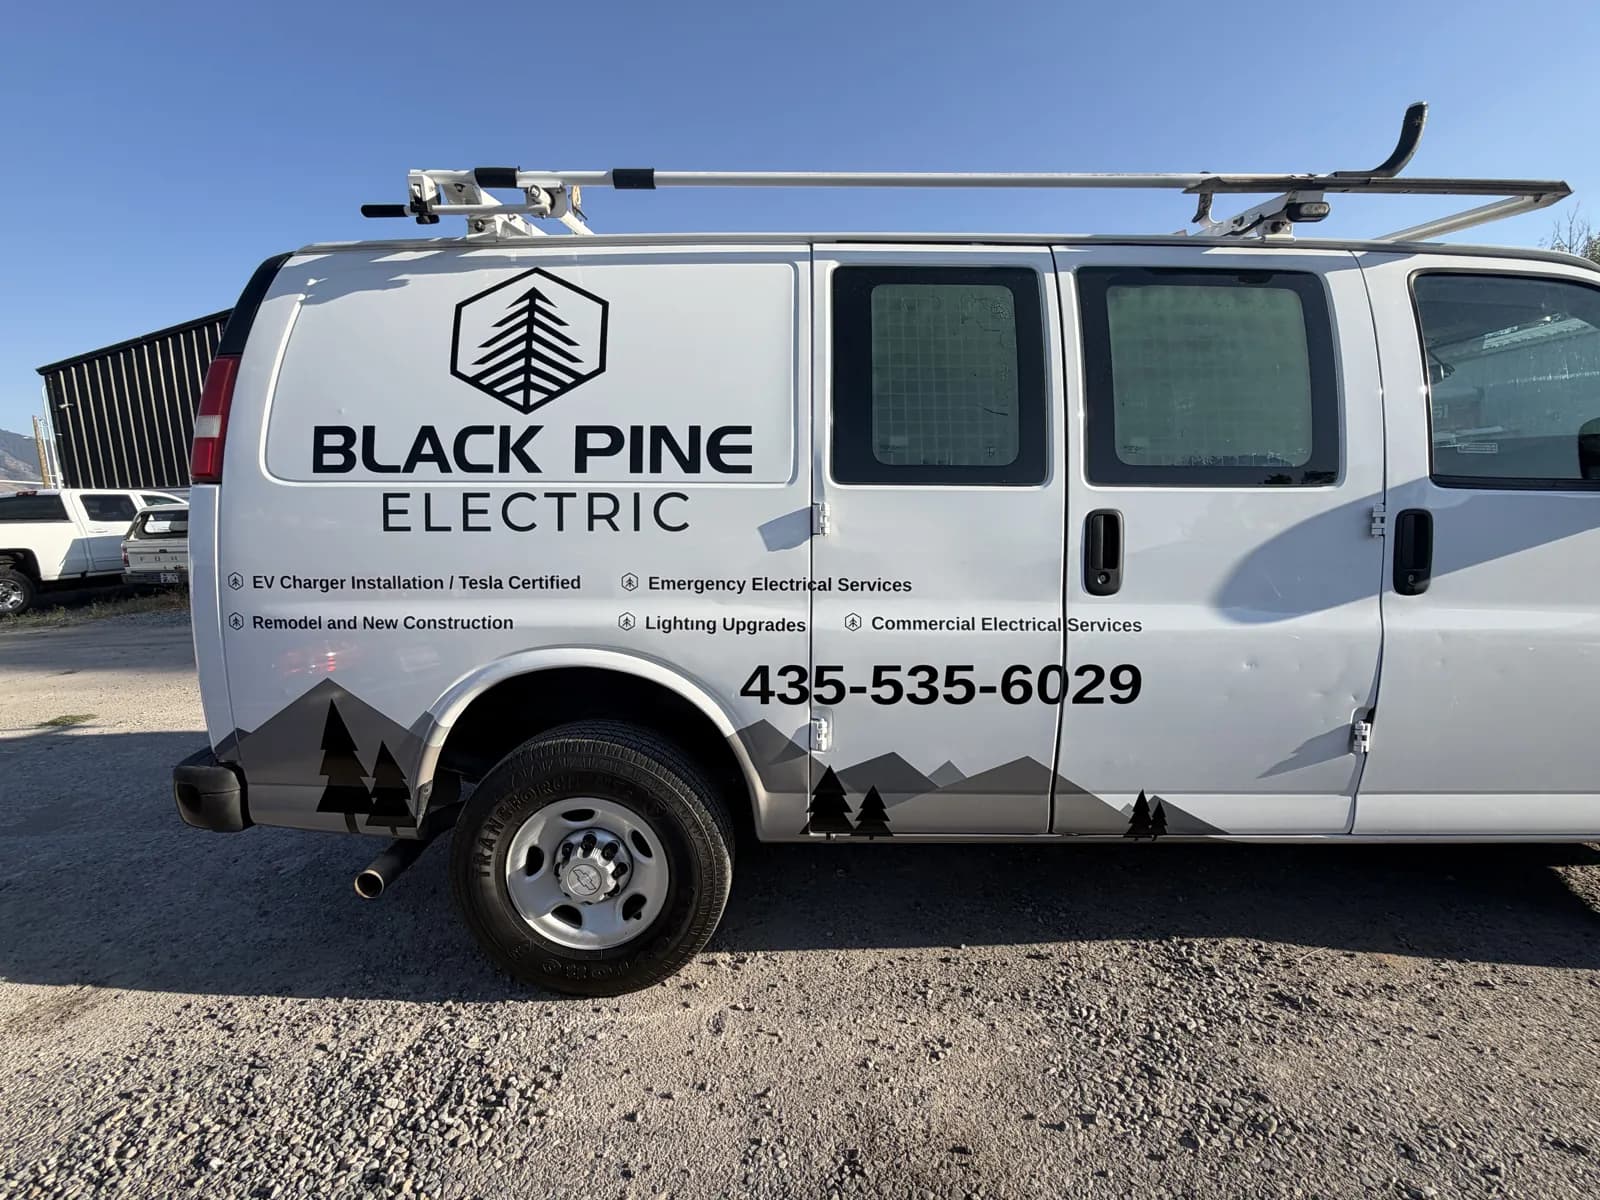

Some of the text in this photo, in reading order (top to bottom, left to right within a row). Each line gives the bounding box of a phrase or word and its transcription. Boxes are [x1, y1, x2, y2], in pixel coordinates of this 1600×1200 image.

[312, 425, 753, 474] BLACK PINE
[382, 491, 690, 533] ELECTRIC
[252, 575, 275, 589] EV
[279, 575, 347, 593] Charger
[351, 575, 444, 590] Installation
[458, 575, 504, 590] Tesla
[508, 575, 581, 590] Certified
[648, 576, 912, 595] Emergency Electrical Services
[252, 615, 514, 631] Remodel and New Construction
[645, 615, 806, 636] Lighting Upgrades
[871, 616, 1143, 632] Commercial Electrical Services
[739, 663, 1142, 706] 435-535-6029
